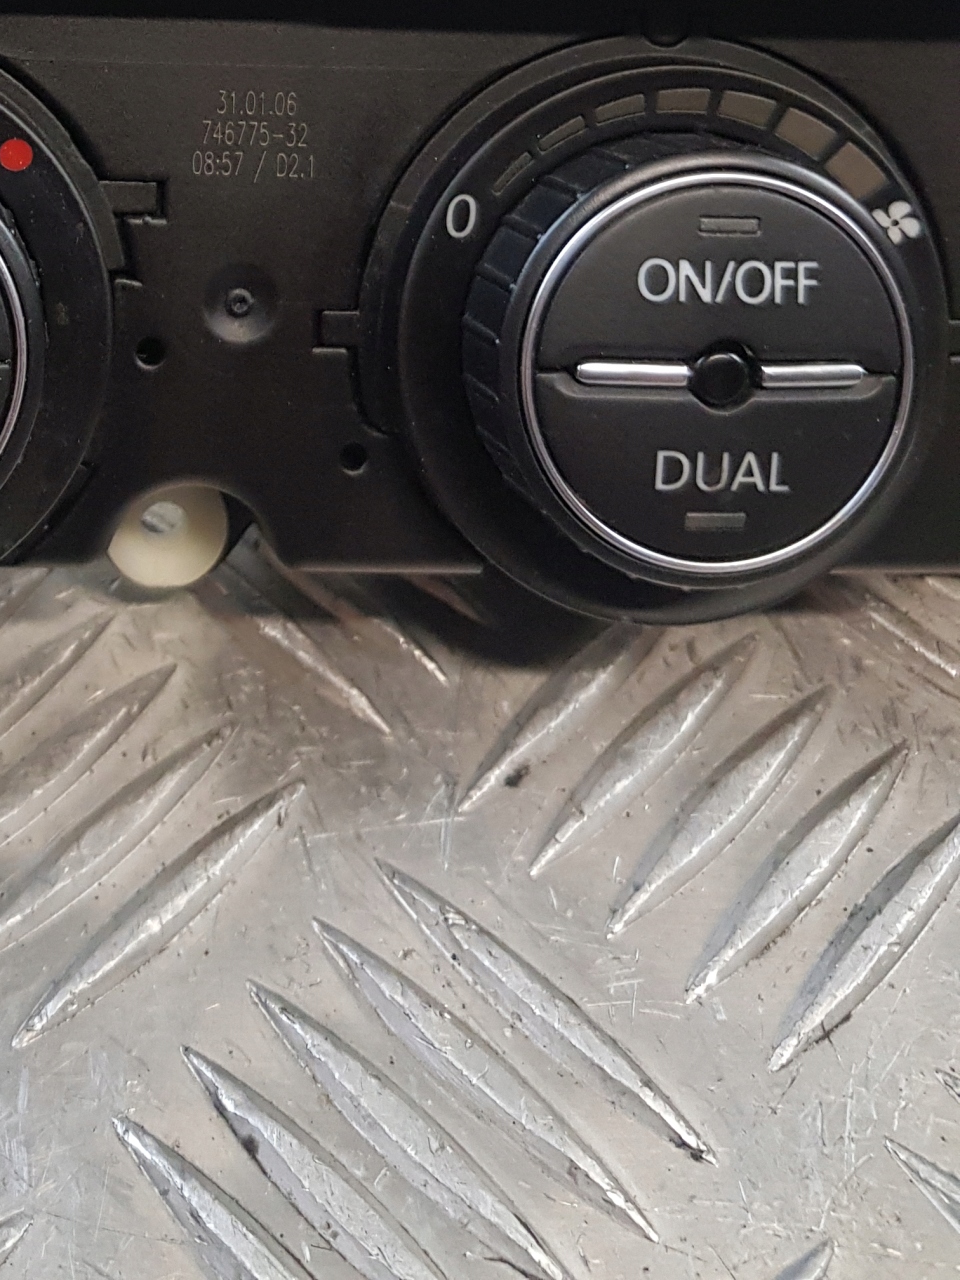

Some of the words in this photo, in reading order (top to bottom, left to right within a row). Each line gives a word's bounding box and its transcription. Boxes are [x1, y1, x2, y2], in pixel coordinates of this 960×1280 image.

[216, 89, 297, 116] 31.01.06
[202, 120, 308, 147] 746775-32
[192, 150, 244, 176] 08:57
[253, 150, 267, 184] /
[276, 152, 314, 179] D2.1
[637, 256, 820, 306] ON/OFF
[654, 450, 791, 494] DUAL
